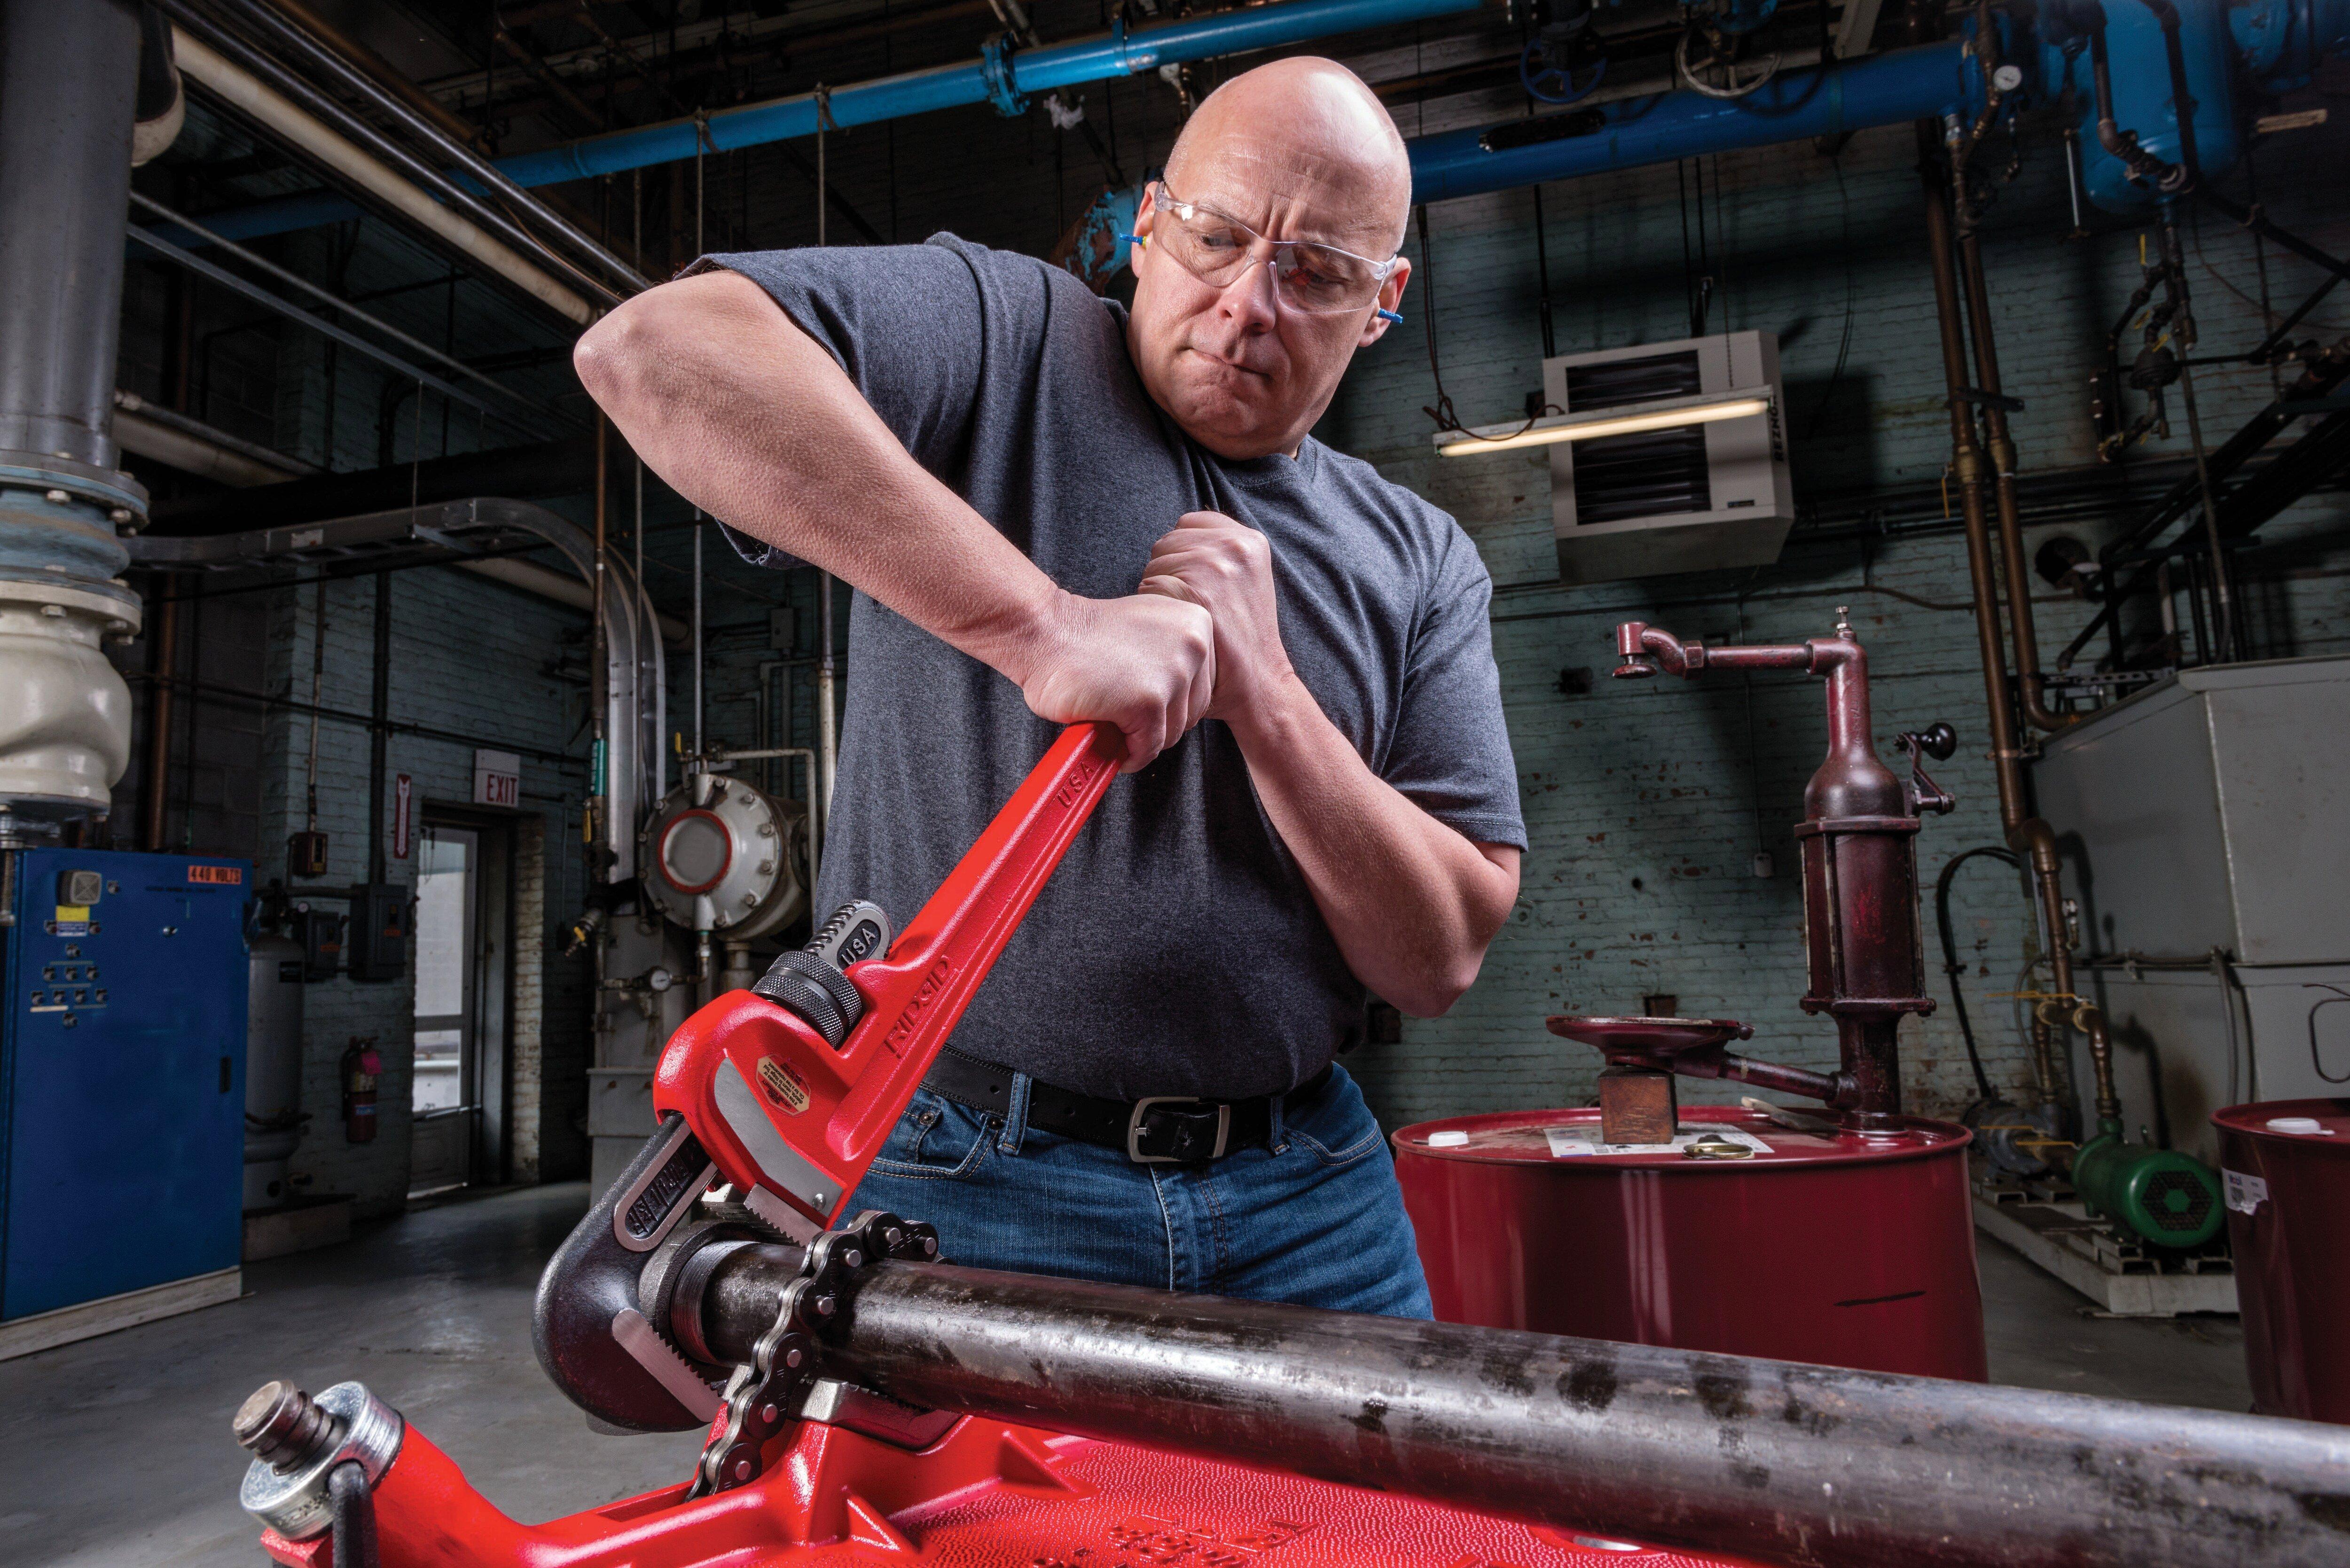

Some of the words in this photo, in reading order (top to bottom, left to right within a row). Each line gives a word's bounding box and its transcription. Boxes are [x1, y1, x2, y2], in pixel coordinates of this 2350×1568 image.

[486, 774, 517, 804] EXIT
[1057, 762, 1095, 808] USA
[191, 866, 211, 881] 440
[216, 867, 240, 883] VOLTS
[841, 928, 876, 965] USA
[883, 954, 949, 1059] RIDGID
[767, 1061, 787, 1081] replacement.
[769, 1070, 779, 1081] Ridge
[767, 1075, 778, 1086] breaks
[782, 1083, 792, 1093] return
[776, 1084, 790, 1098] housing
[790, 1091, 803, 1104] distorts,
